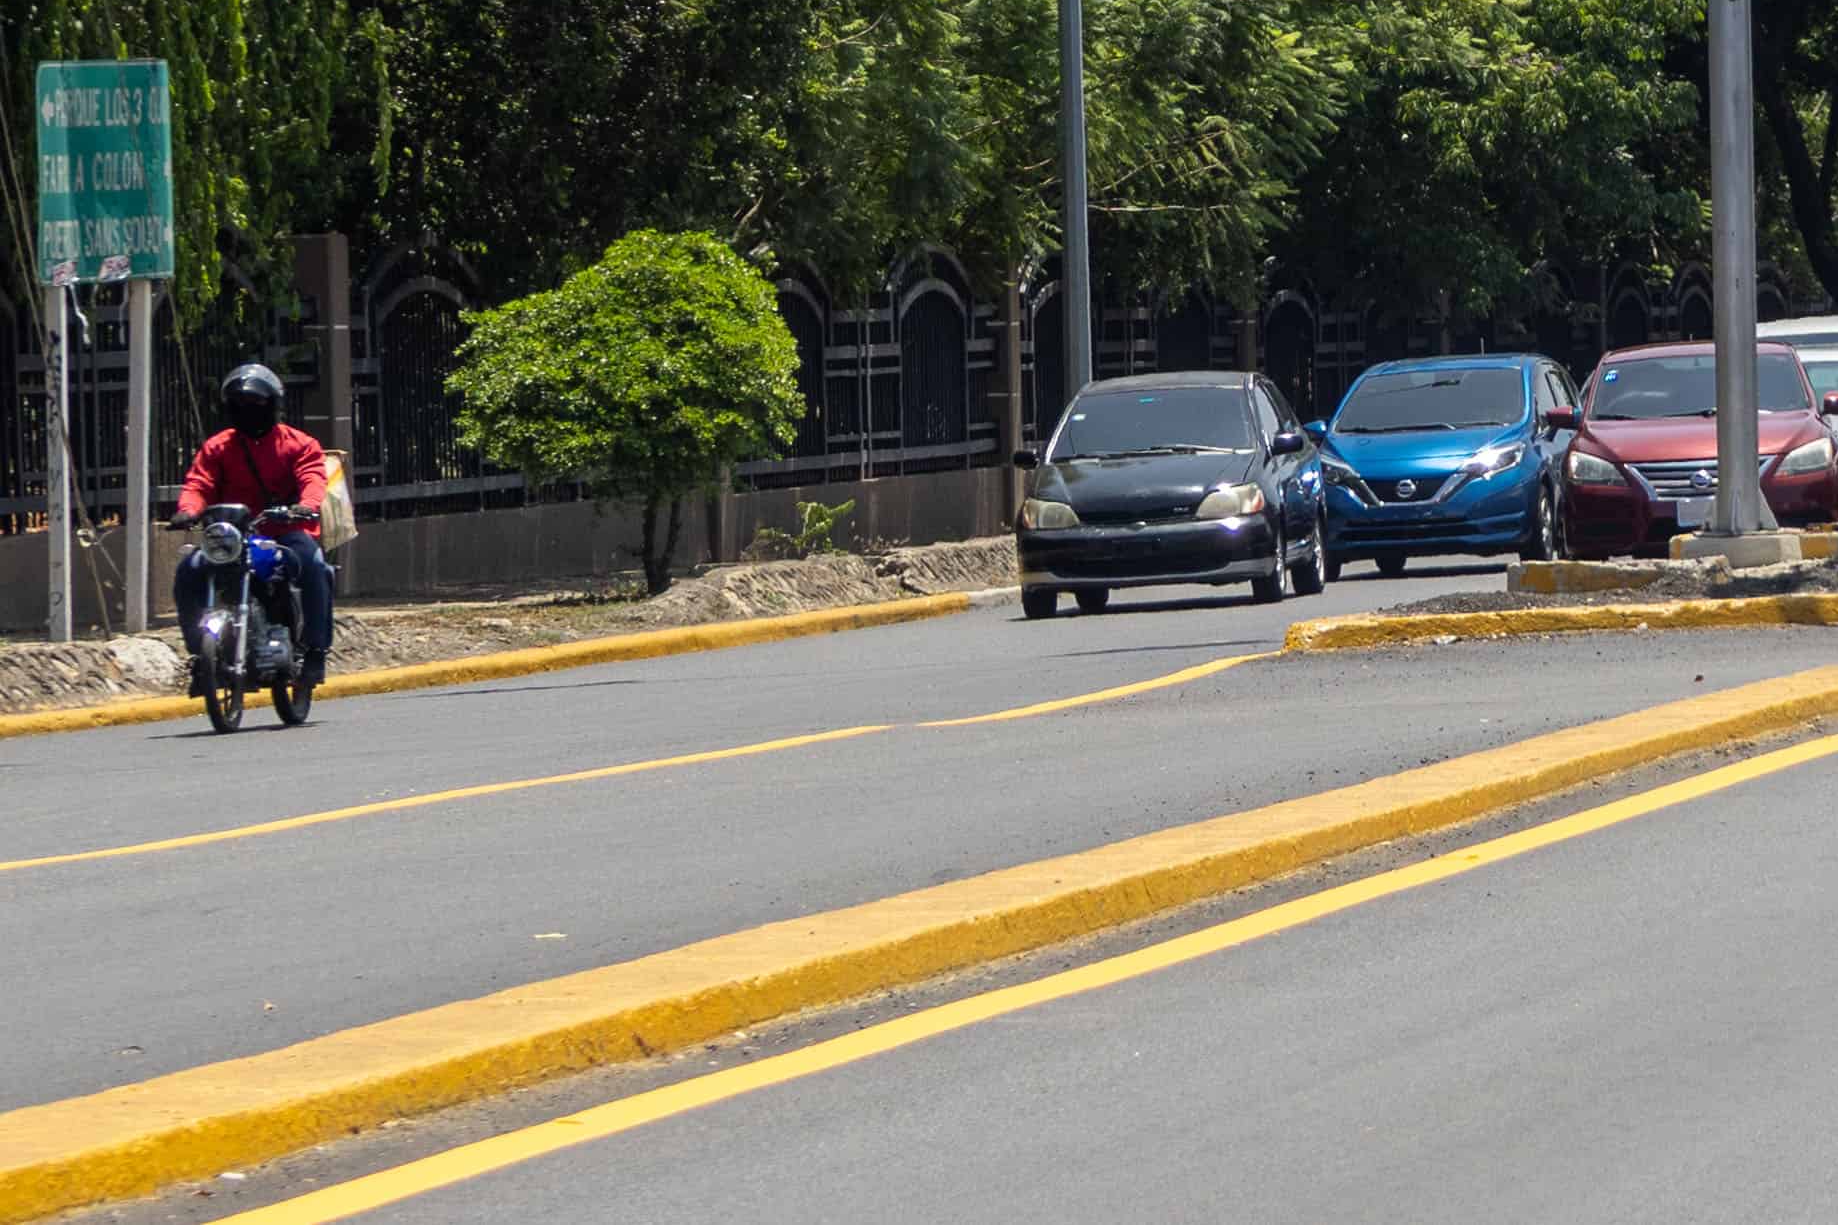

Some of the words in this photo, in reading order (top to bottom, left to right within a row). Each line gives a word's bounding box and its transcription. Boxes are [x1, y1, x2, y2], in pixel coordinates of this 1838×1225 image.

[104, 88, 130, 126] LOS
[132, 87, 143, 126] 3
[75, 154, 85, 192] A
[92, 151, 145, 191] COLON
